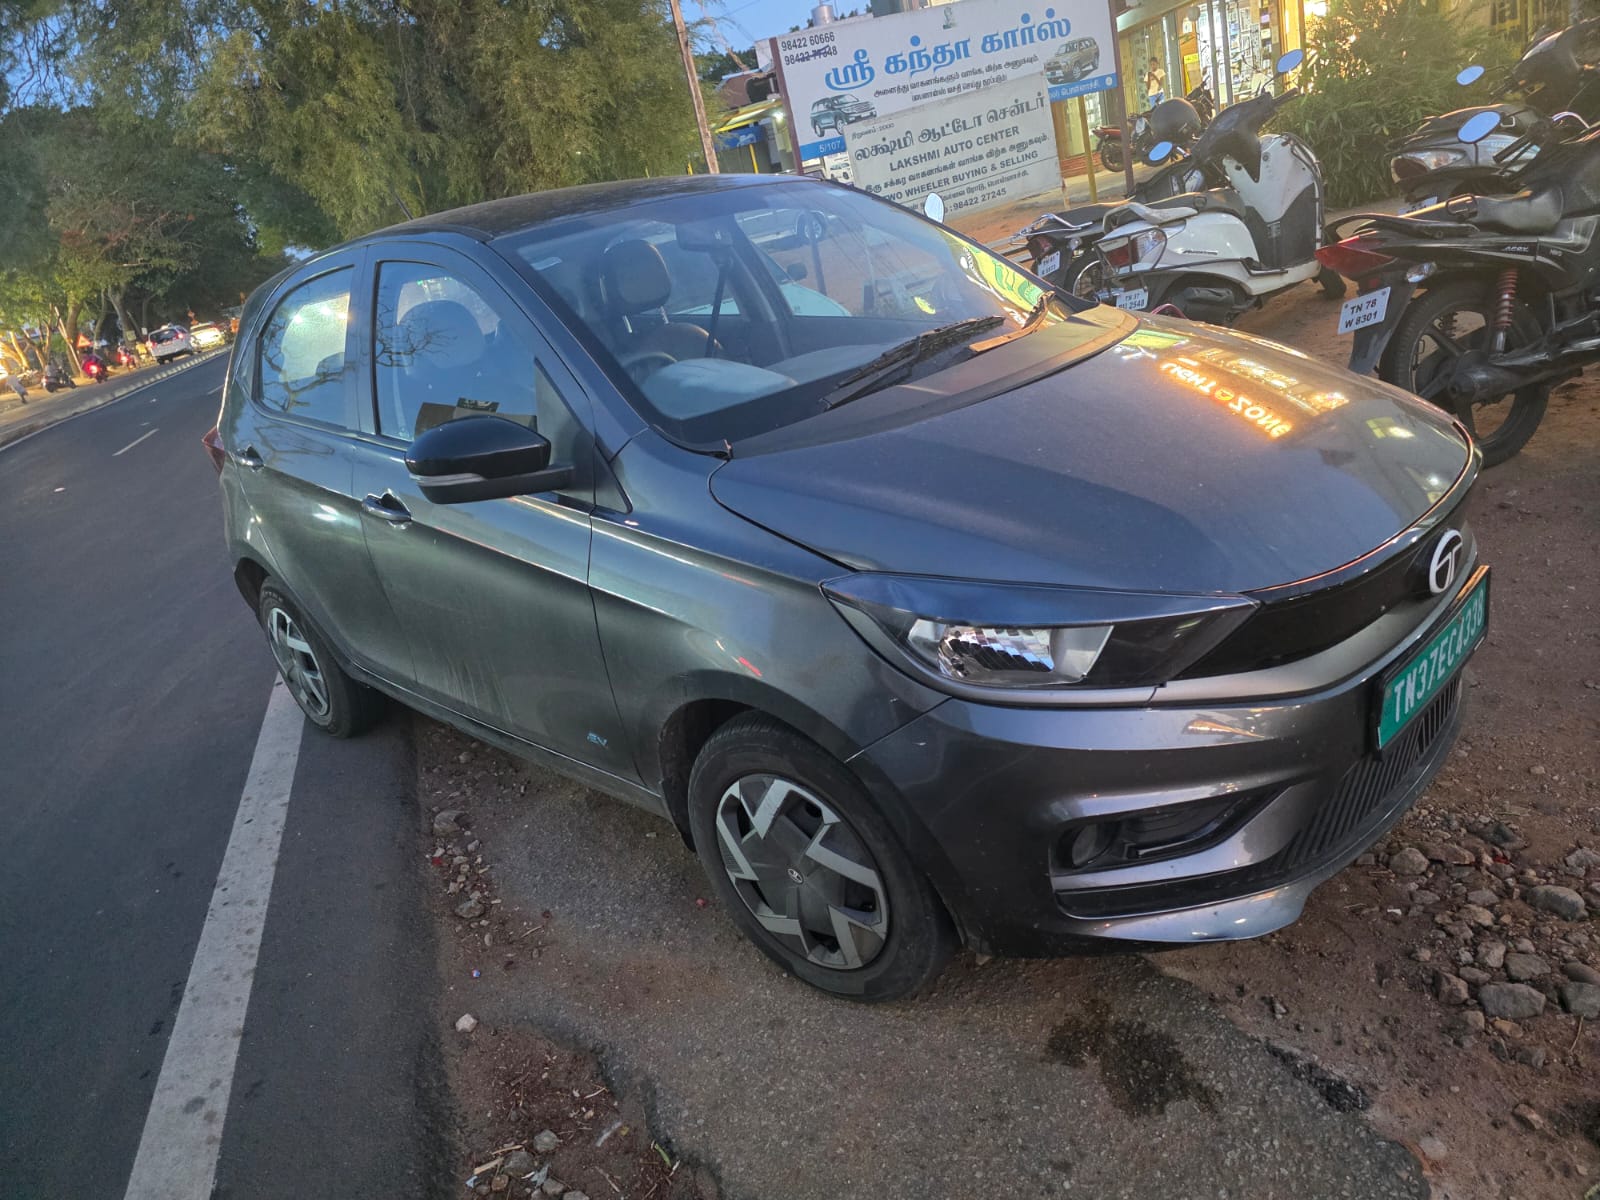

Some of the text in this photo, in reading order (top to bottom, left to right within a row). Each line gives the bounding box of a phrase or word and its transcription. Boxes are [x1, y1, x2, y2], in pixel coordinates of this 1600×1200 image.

[781, 32, 835, 51] 98422 60666
[884, 35, 972, 78] கந்தா
[981, 7, 1071, 53] கார்ஸ்
[918, 114, 982, 143] ஆட்டோ
[986, 91, 1045, 123] சென்டர்
[890, 125, 1020, 172] LAKSHMI AUTO CENTER
[905, 177, 950, 198] WHEELER
[952, 165, 988, 183] BUYING
[990, 163, 998, 172] &
[1000, 150, 1038, 169] SELLING
[980, 187, 1007, 202] 27245
[1345, 311, 1378, 328] W 8301
[1350, 303, 1363, 315] TN
